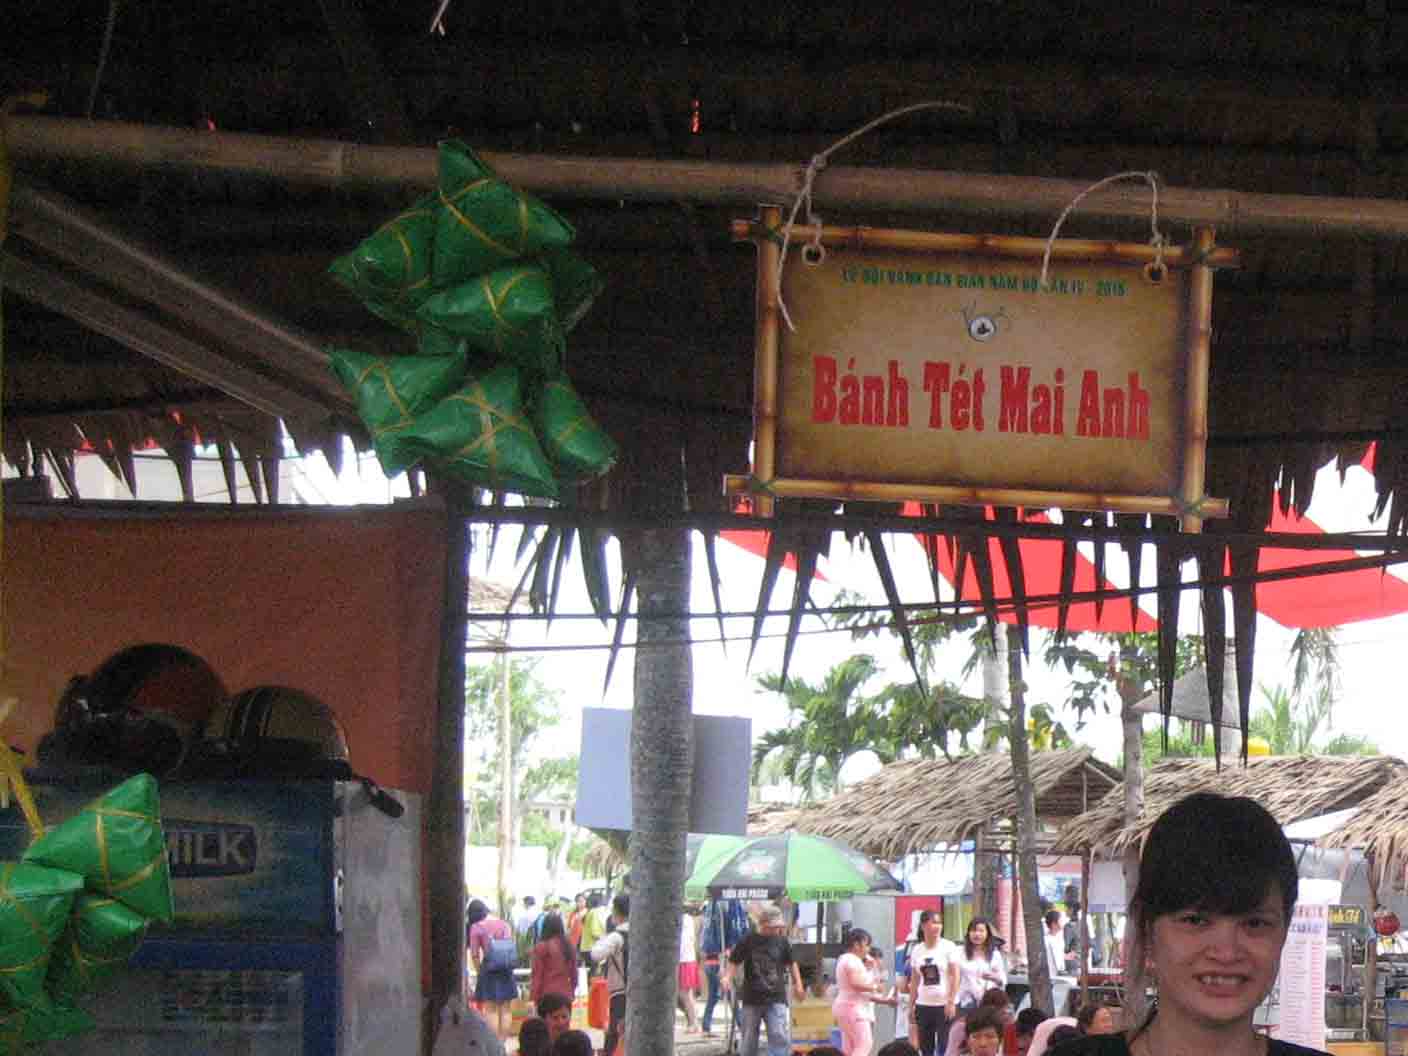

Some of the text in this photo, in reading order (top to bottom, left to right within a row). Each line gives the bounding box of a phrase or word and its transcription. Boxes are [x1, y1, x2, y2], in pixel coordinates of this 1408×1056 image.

[811, 355, 1151, 440] Bánh Tét Mai Anh
